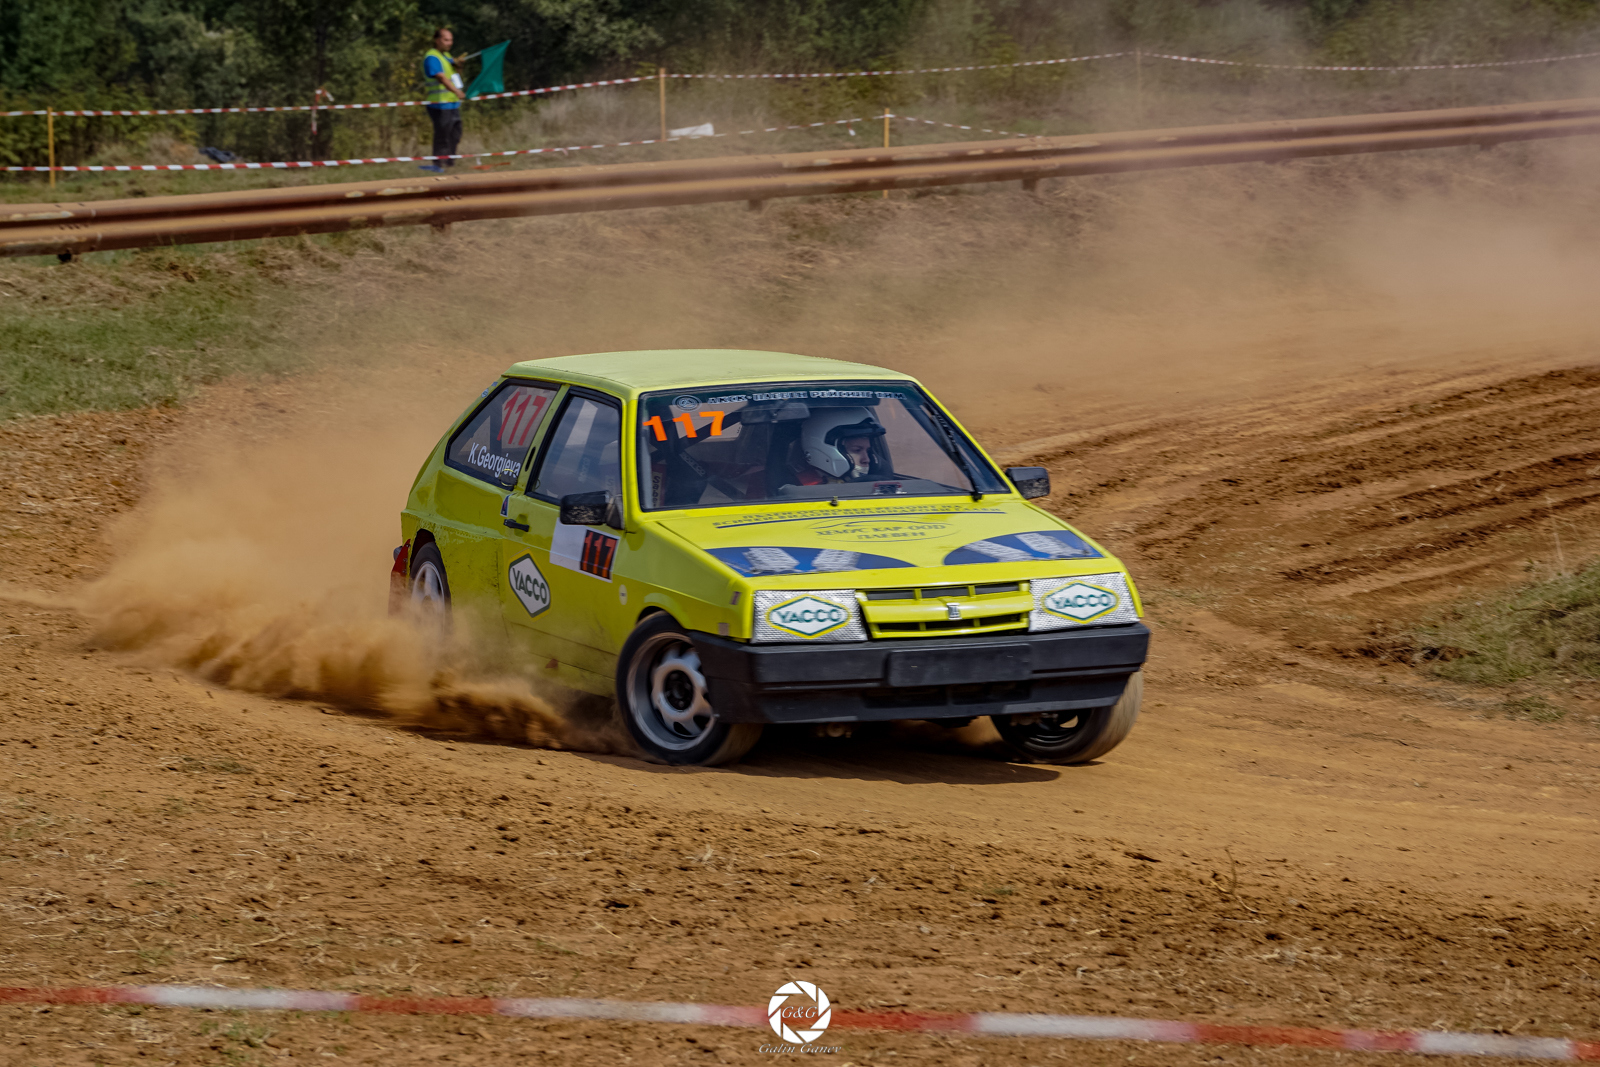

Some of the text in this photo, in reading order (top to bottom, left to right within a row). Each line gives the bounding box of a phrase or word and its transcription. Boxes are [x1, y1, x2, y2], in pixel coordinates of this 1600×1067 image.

[497, 391, 547, 446] 117
[642, 410, 726, 442] 117
[467, 442, 522, 478] K.Georgieva
[856, 531, 926, 540] ПЛЕВЕН
[582, 531, 618, 578] 117
[512, 567, 548, 605] YACCO
[1051, 593, 1111, 609] YACCO
[776, 608, 841, 623] YACCO
